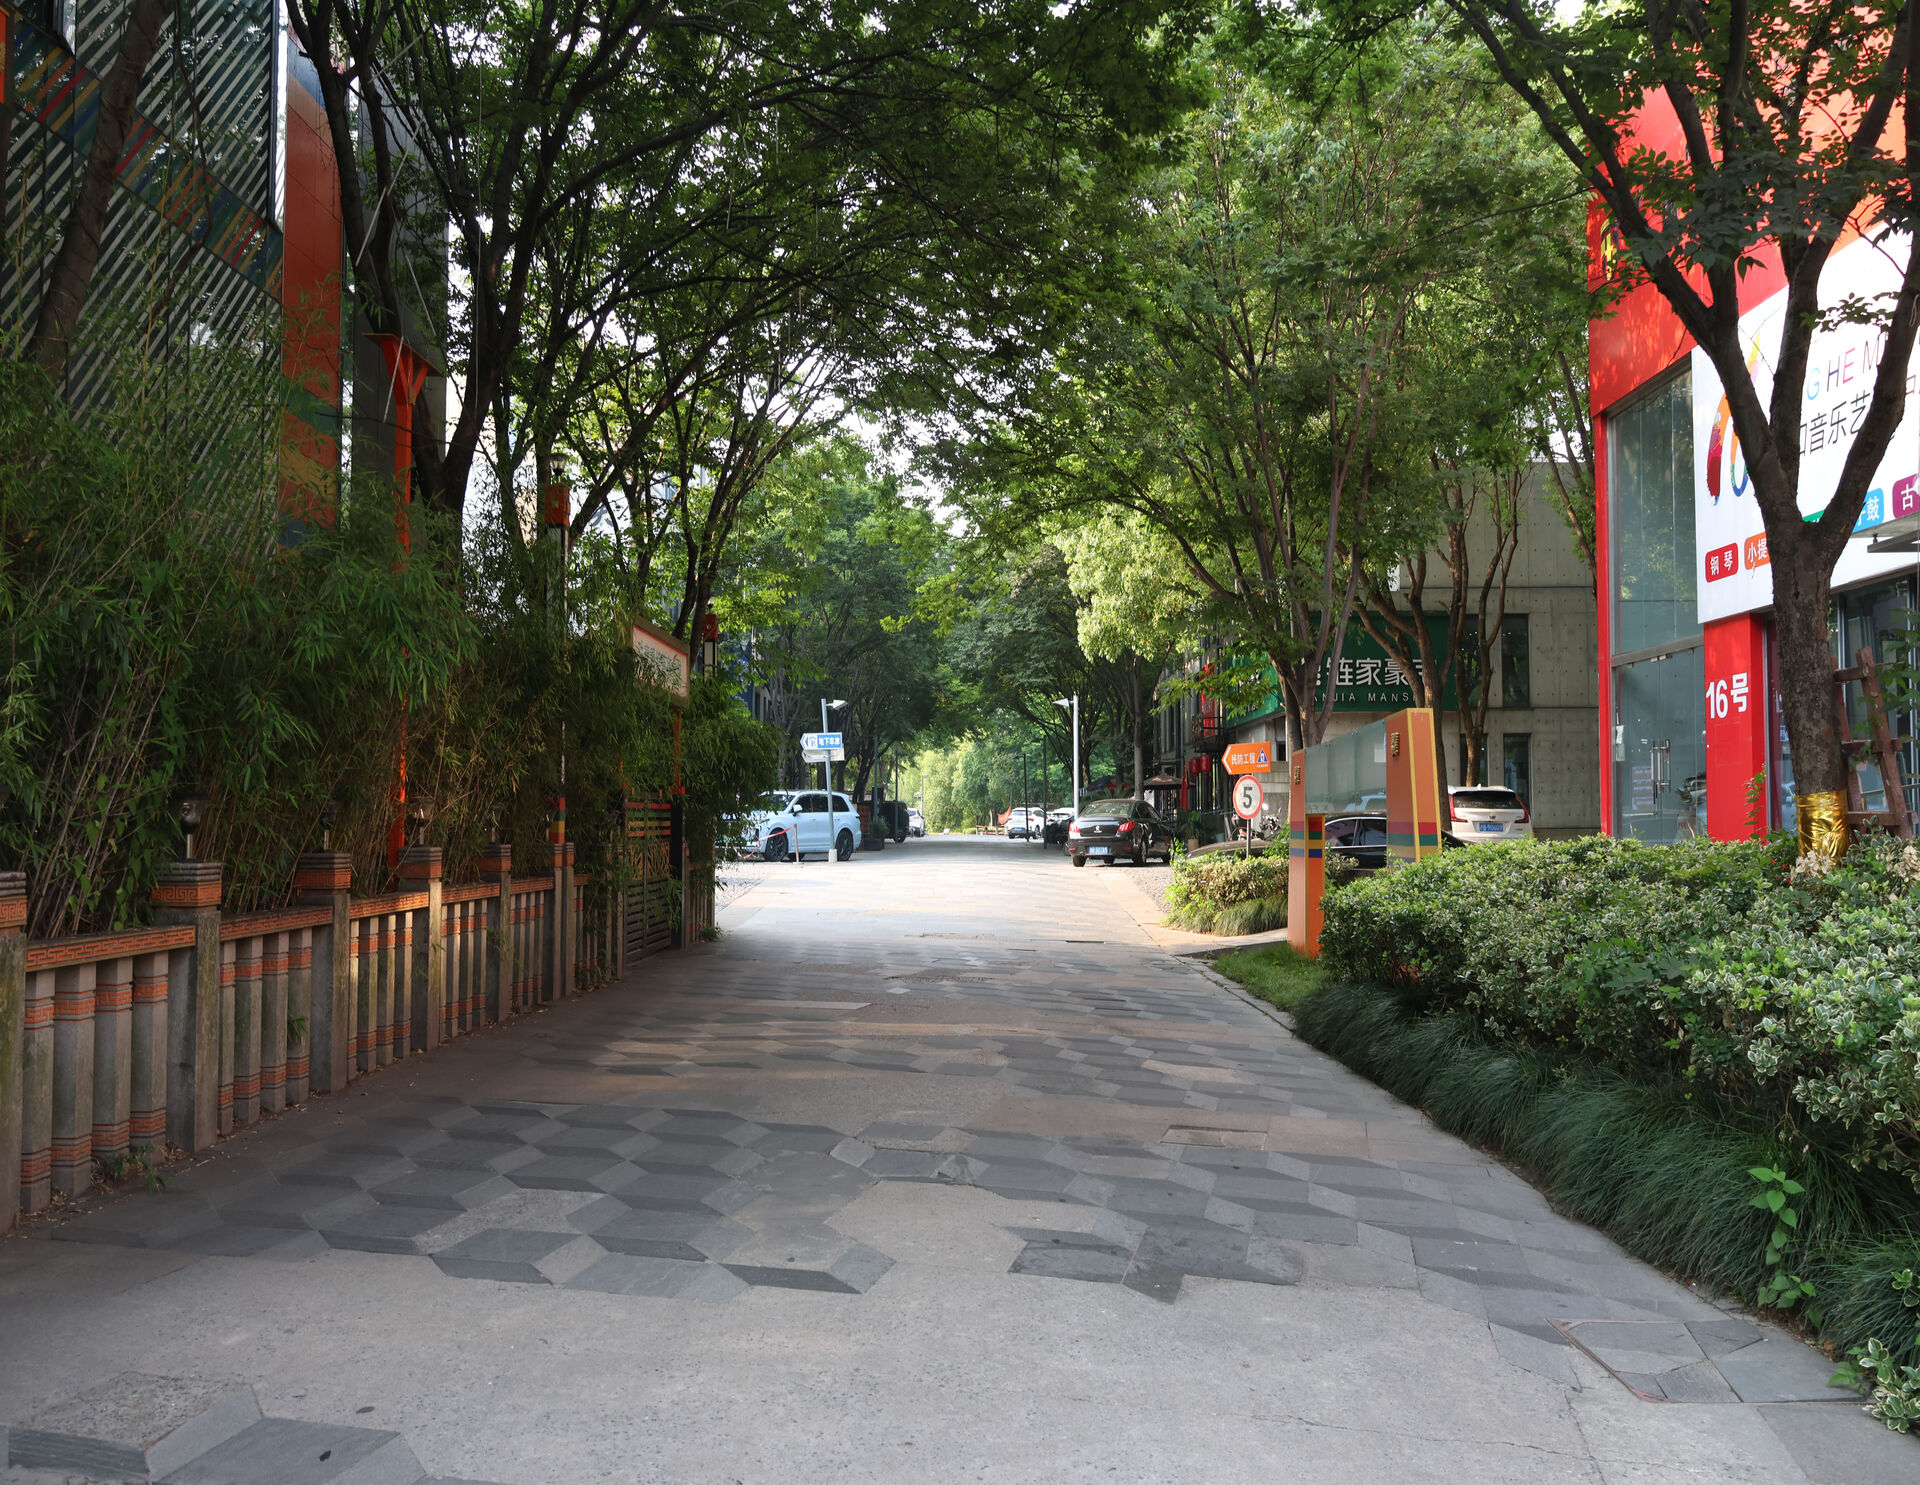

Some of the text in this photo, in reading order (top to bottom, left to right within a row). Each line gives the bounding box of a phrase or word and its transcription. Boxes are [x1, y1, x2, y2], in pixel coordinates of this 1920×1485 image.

[1710, 549, 1734, 577] 钢琴
[1705, 672, 1749, 719] 16号
[1242, 786, 1253, 809] 5
